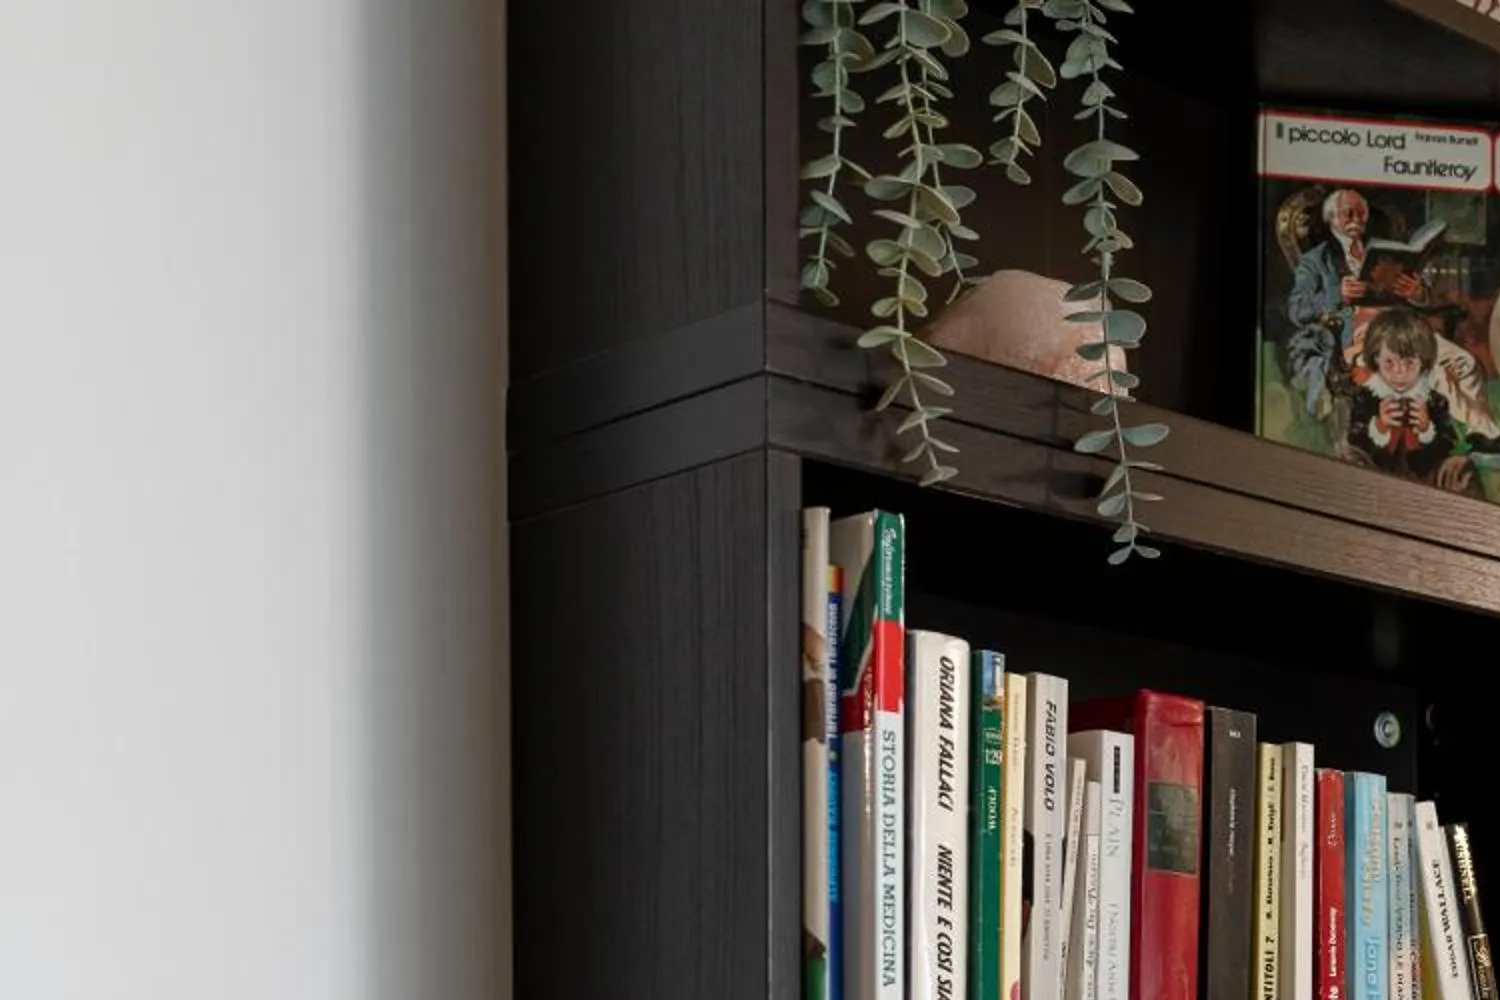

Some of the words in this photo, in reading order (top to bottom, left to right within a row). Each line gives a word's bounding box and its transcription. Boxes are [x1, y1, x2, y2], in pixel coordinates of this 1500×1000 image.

[1289, 127, 1361, 147] piccolo
[1367, 130, 1406, 149] Lord
[1383, 155, 1478, 182] Fauntleroy
[939, 656, 955, 729] ORIANA
[1045, 699, 1057, 756] FABIO
[882, 731, 896, 807] STORIA
[938, 736, 954, 812] FALLACI
[1044, 763, 1056, 812] VOLO
[987, 785, 998, 831] WOOLF
[1106, 799, 1125, 858] PLAIN
[883, 814, 895, 877] DELLA
[938, 844, 953, 910] NIENTE
[1432, 858, 1451, 933] WALLACE
[883, 885, 895, 988] MEDICINA
[938, 916, 952, 930] E
[938, 932, 952, 972] COSI
[1364, 936, 1382, 986] Jane
